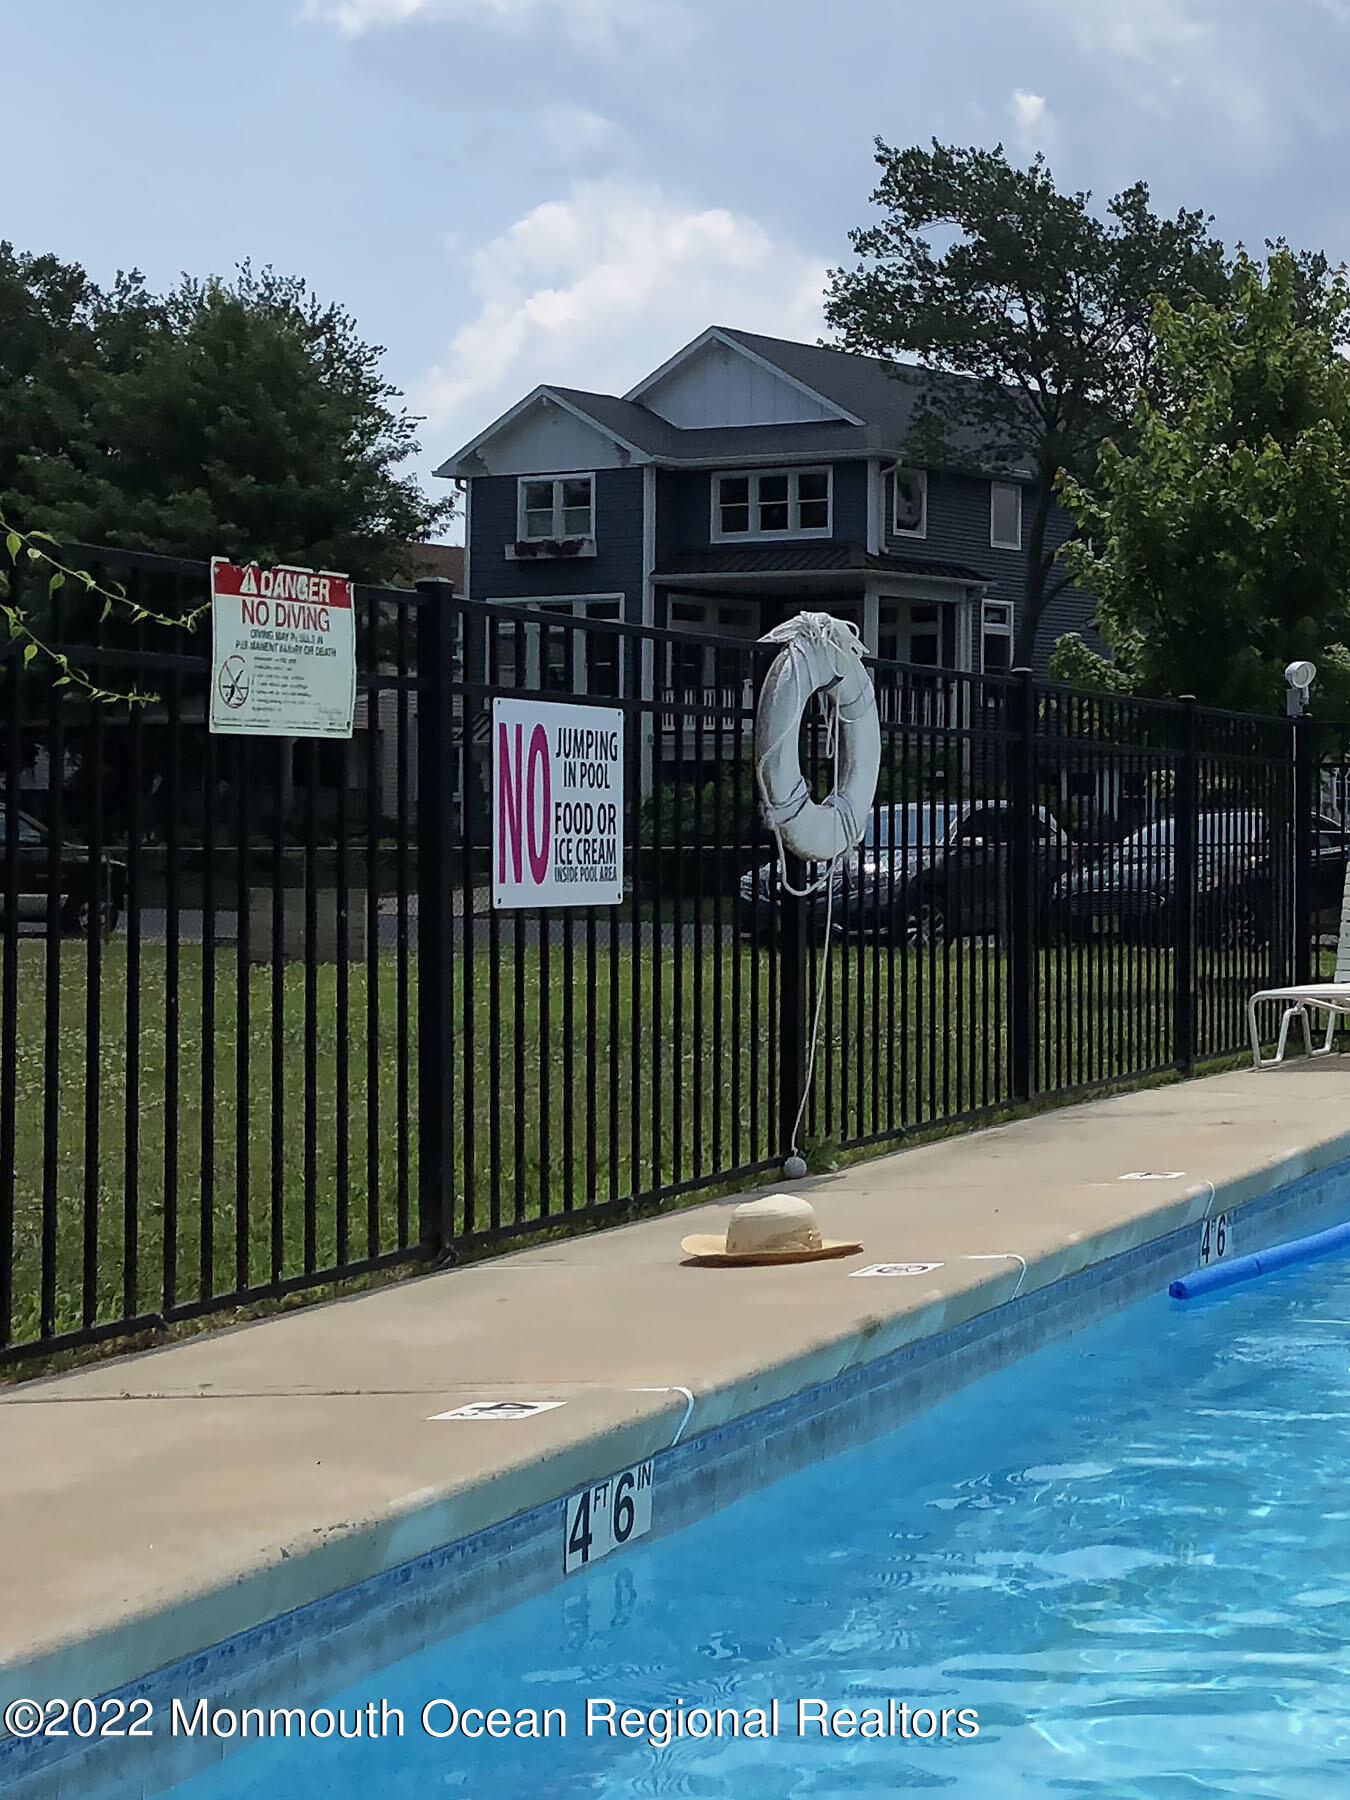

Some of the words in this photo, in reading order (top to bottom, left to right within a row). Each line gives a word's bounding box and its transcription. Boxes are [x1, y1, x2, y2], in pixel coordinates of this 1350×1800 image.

[261, 570, 330, 602] DANGER
[241, 599, 270, 626] NO
[274, 602, 330, 632] DIVING
[555, 727, 618, 761] JUMPING
[563, 761, 577, 788] IN
[579, 762, 611, 789] POOL
[499, 722, 551, 885] NO
[554, 802, 594, 835] FOOD
[597, 803, 617, 835] OR
[554, 838, 573, 866] ICE
[575, 838, 617, 866] CREAM
[554, 866, 578, 883] INSIDE
[579, 867, 598, 883] POOL
[599, 867, 618, 883] AREA
[1202, 1220, 1210, 1264] 4
[1217, 1215, 1226, 1256] 6
[568, 1490, 593, 1563] 4
[593, 1482, 610, 1512] FT
[613, 1472, 635, 1543] 6
[637, 1461, 652, 1491] IN
